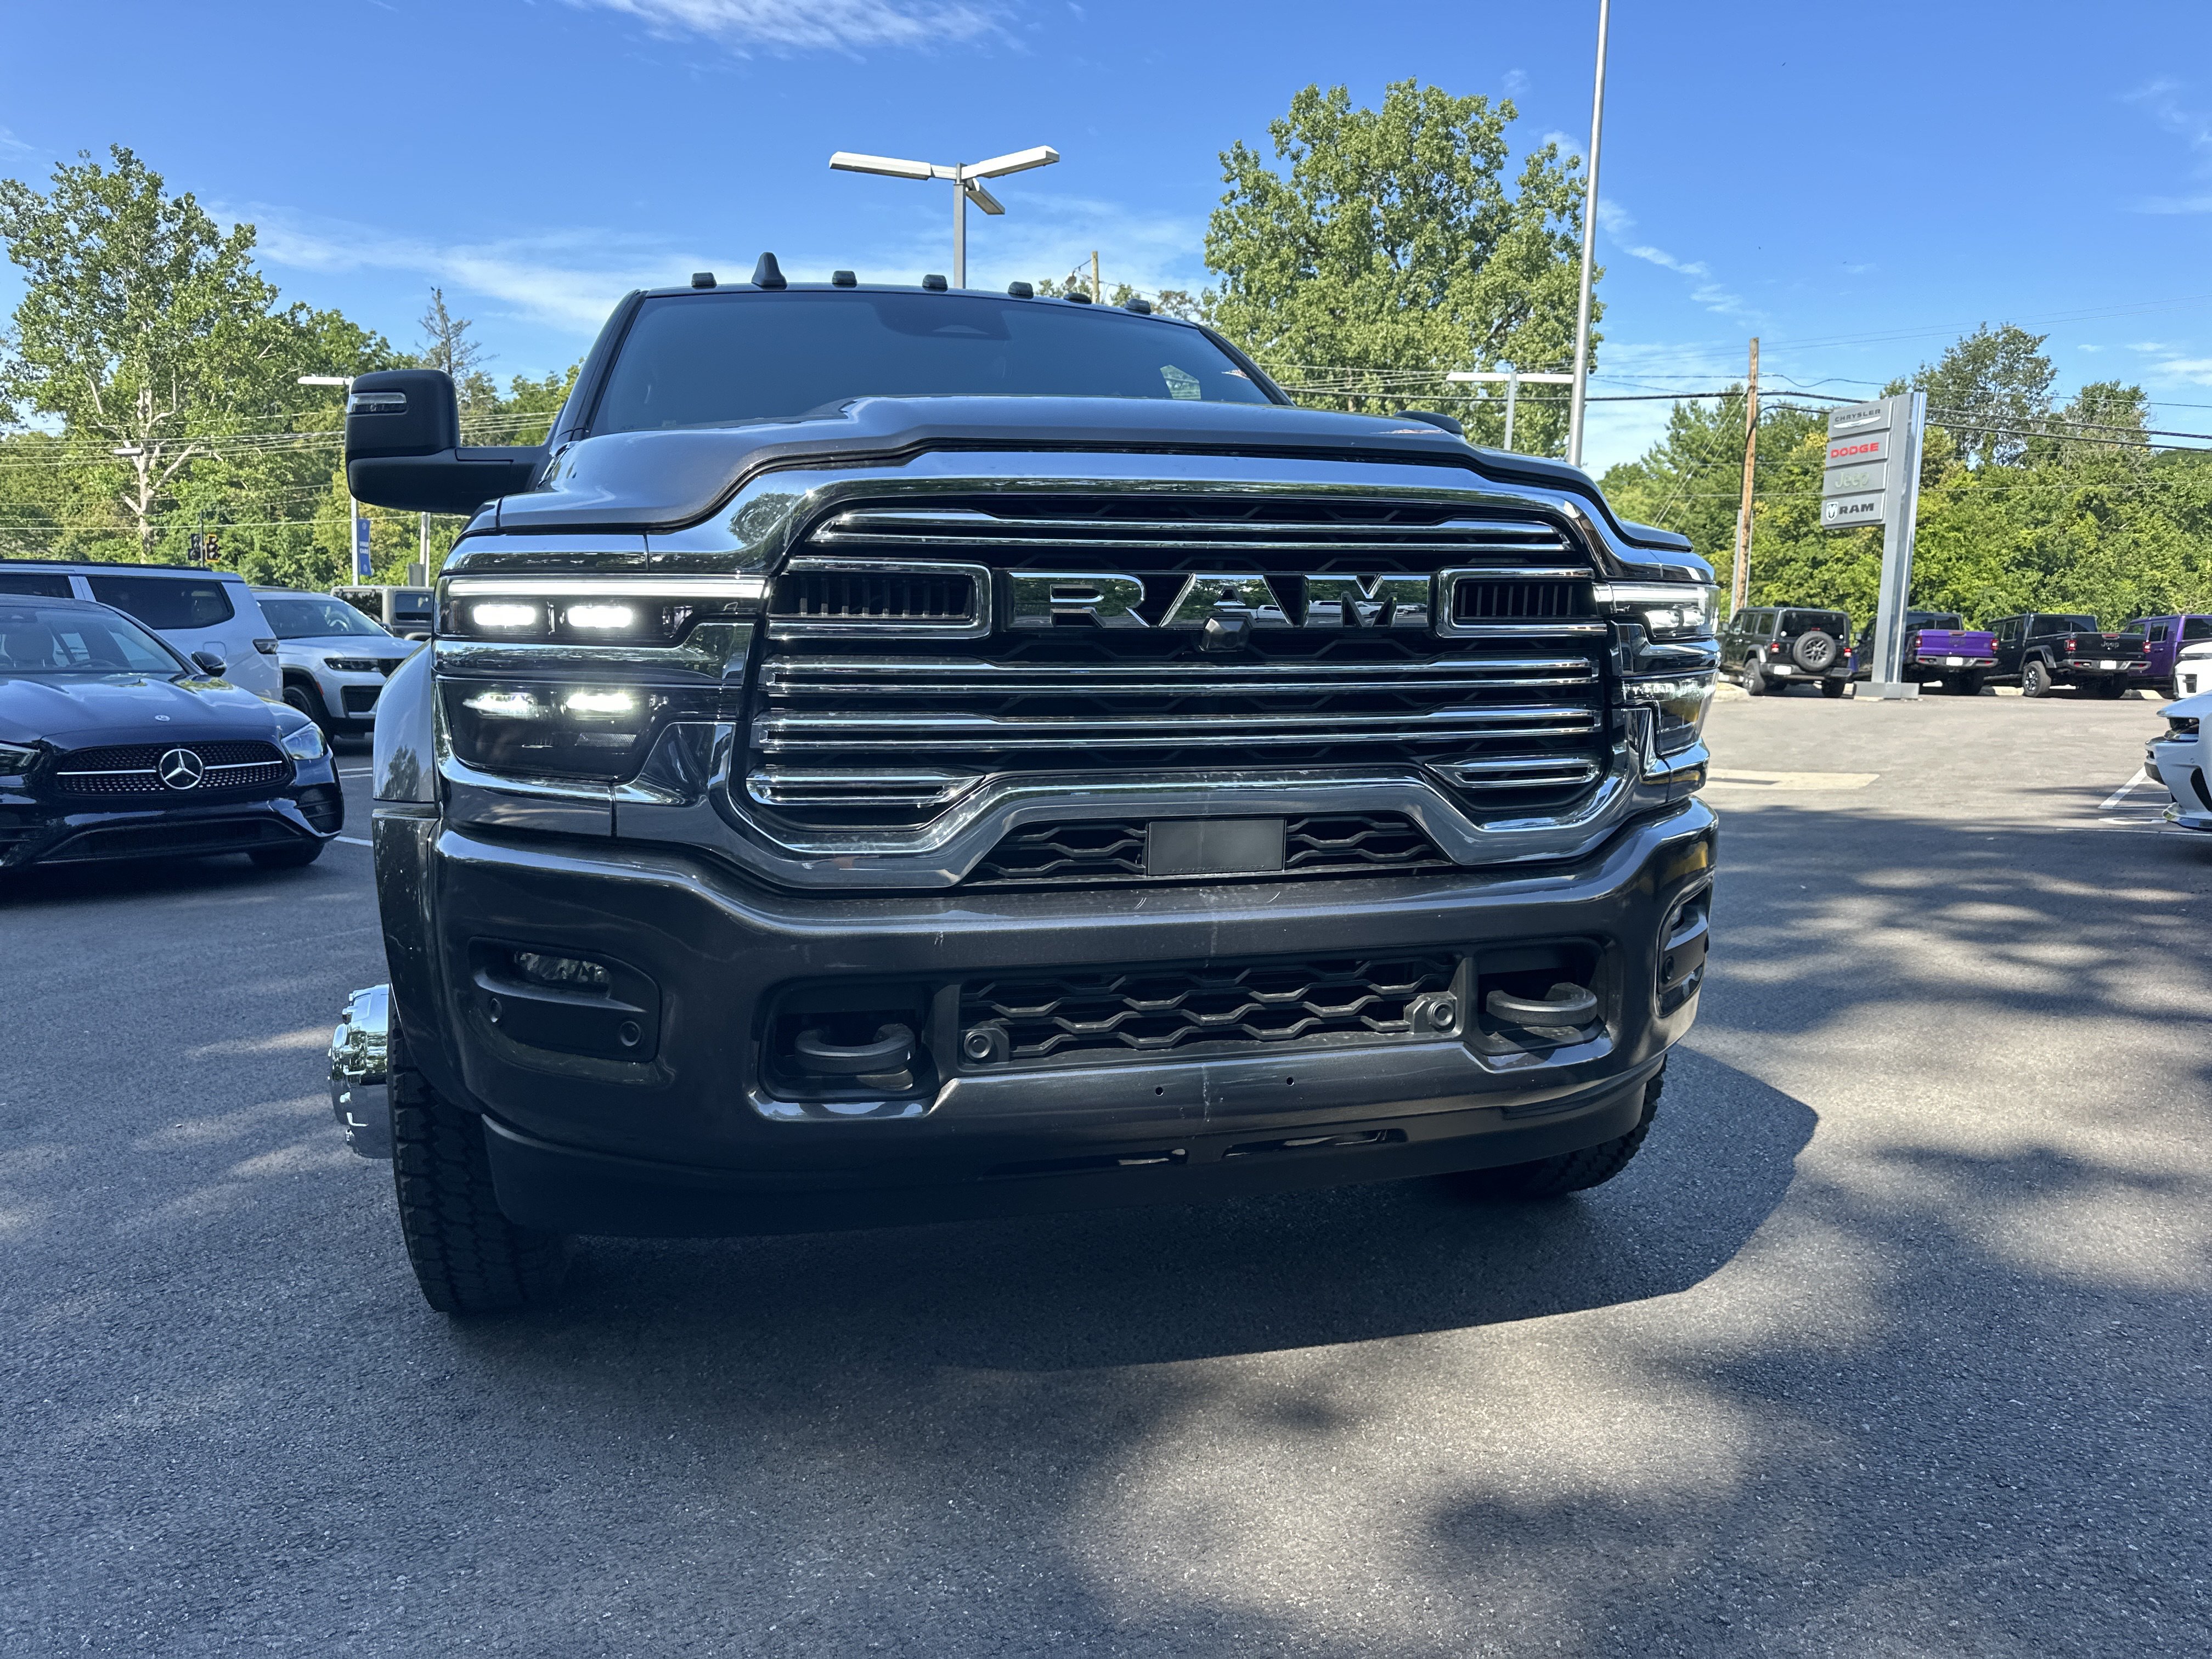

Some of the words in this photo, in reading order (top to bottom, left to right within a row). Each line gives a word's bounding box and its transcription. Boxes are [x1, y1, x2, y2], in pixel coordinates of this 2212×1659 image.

[1835, 409, 1881, 422] CHRYSLER
[1830, 442, 1879, 458] DODGE
[1835, 471, 1870, 488] Jeep
[1839, 503, 1874, 515] RAM
[1008, 571, 1432, 628] RAM
[2101, 640, 2120, 648] Jeep
